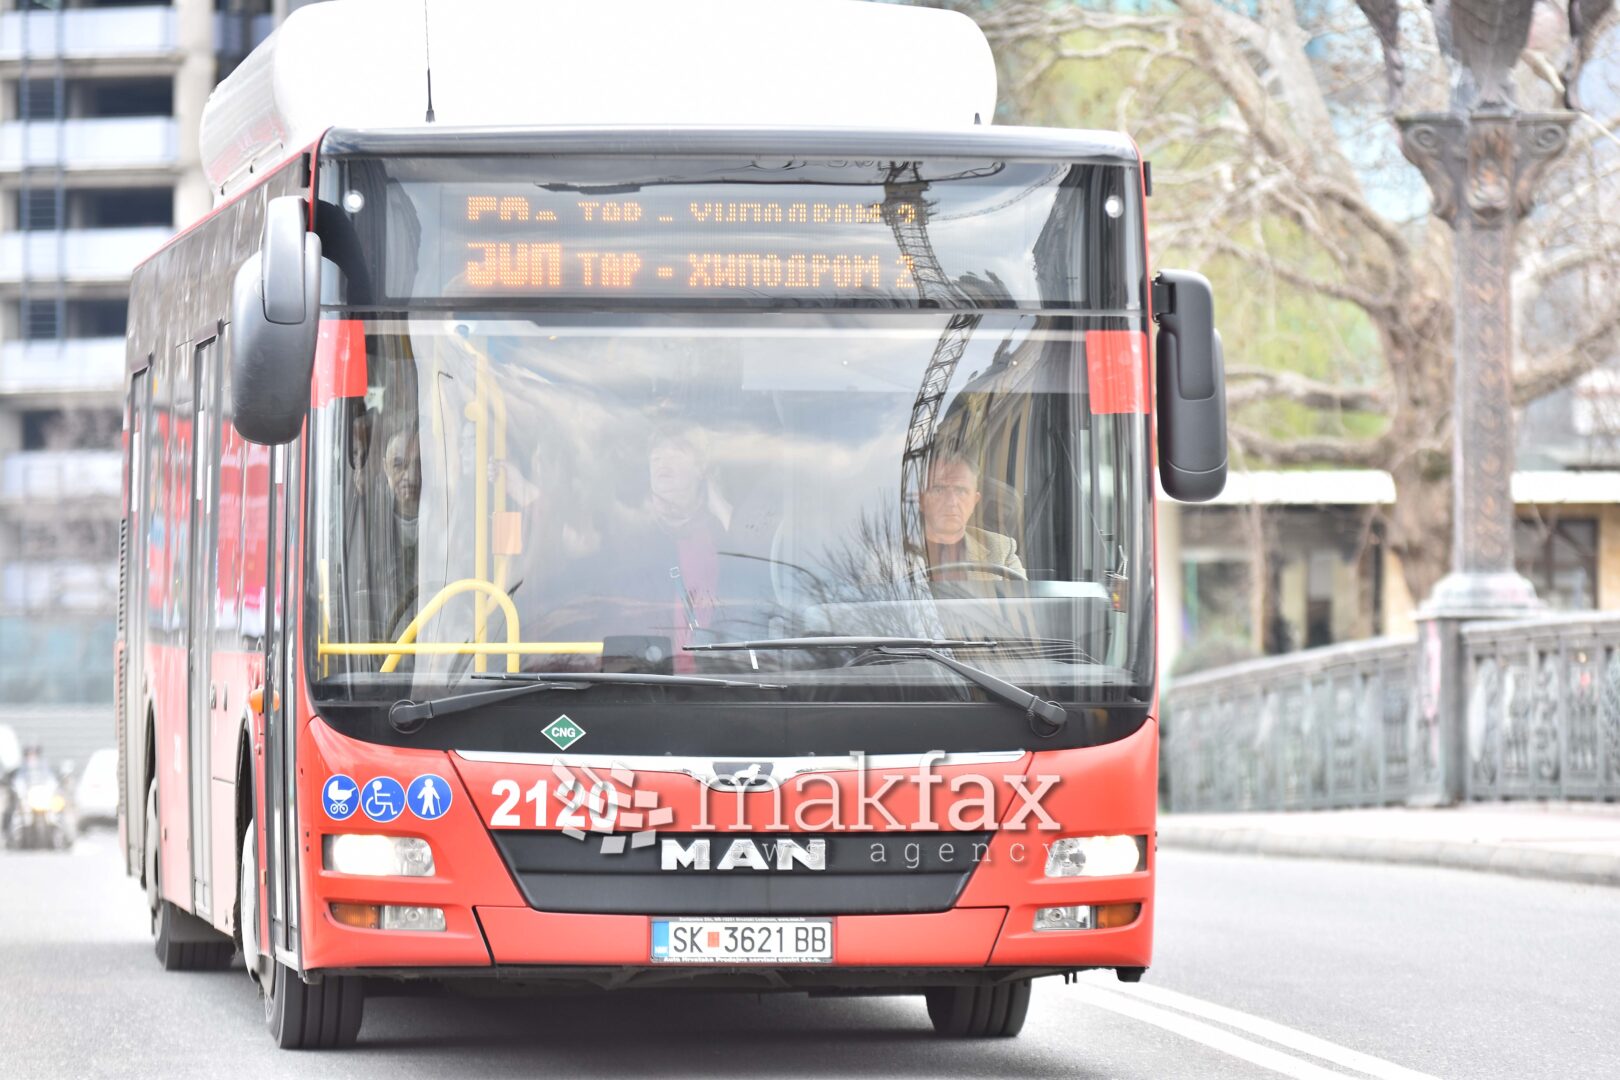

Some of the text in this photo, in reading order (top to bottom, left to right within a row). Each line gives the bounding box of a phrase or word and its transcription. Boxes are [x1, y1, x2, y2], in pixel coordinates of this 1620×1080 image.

[689, 253, 880, 287] ХИПОДРОМ
[551, 726, 576, 738] CNG
[490, 779, 618, 828] 2120
[661, 838, 826, 871] MAN
[673, 926, 826, 953] SK 3621 BB
